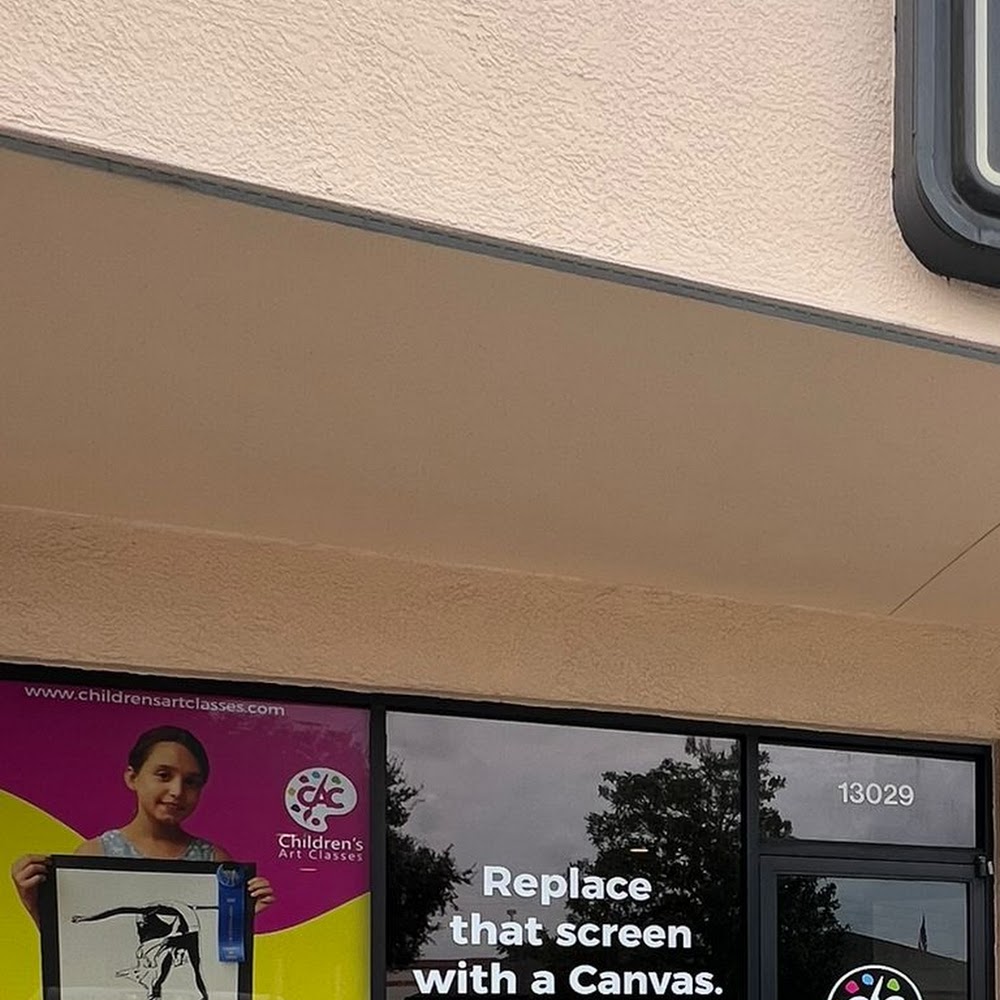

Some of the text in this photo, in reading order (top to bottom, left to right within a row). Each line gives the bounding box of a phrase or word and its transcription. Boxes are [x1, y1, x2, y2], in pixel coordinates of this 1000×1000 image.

[25, 685, 286, 717] www.childrensartclasses.com
[297, 773, 345, 809] CAC
[838, 781, 914, 806] 13029
[278, 834, 364, 851] Children's
[278, 848, 364, 862] Art Classes
[483, 866, 651, 905] Replace
[450, 913, 691, 948] that screen
[412, 961, 723, 995] with a Canvas.
